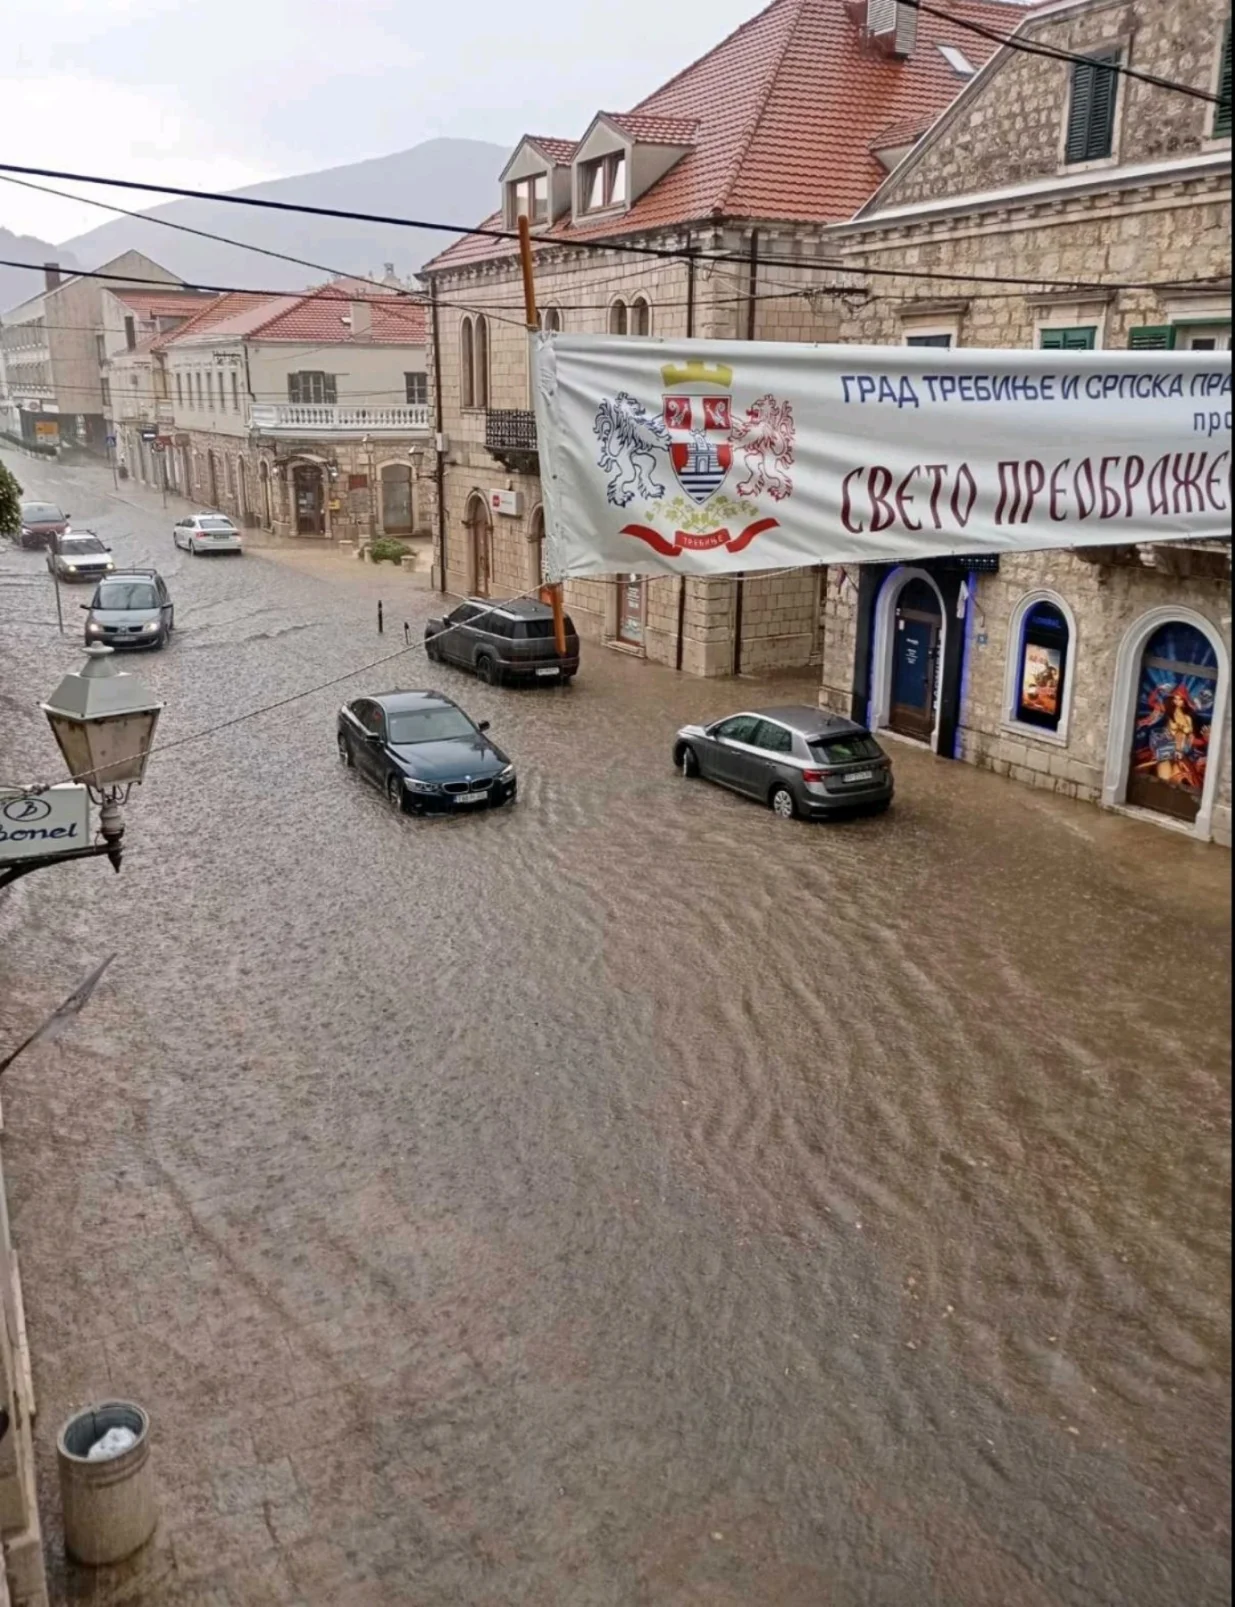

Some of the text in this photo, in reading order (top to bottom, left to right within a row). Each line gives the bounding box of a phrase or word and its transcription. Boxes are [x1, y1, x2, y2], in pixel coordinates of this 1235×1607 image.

[840, 375, 919, 408] ГРАД
[922, 374, 1055, 402] ТРЕБИЊЕ
[1061, 374, 1081, 400] И
[1085, 373, 1184, 400] СРПСКА
[840, 450, 1232, 534] СВЕТО ПРЕОБРАЖЕ
